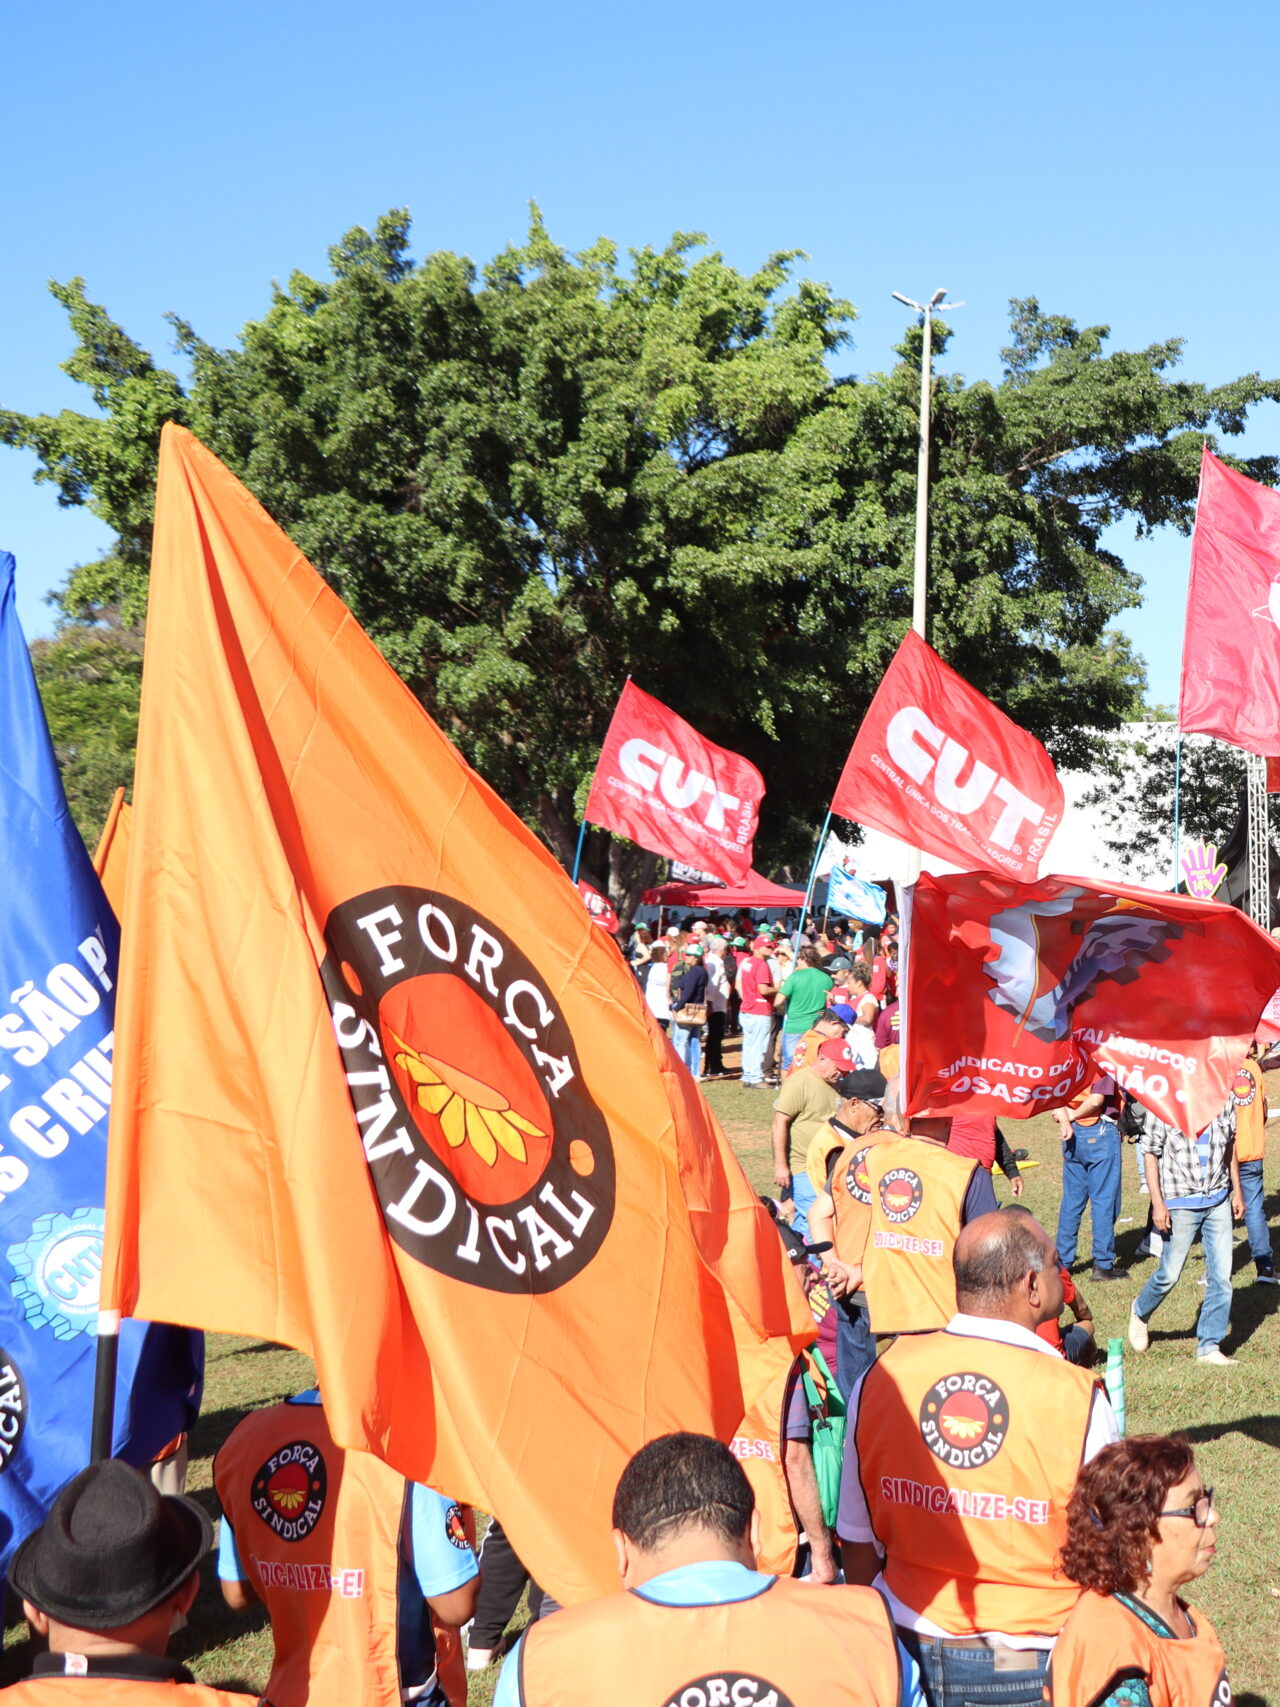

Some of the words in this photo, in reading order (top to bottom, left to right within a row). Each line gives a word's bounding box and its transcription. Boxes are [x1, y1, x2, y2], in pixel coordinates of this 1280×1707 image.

[619, 738, 740, 831] CUT
[871, 753, 904, 789] CENTRAL
[905, 783, 930, 809] ÚNICA
[930, 805, 949, 825] DOS
[887, 707, 1045, 851] CUT
[0, 962, 101, 1067] SÃO
[356, 903, 575, 1098] FORÇA
[936, 1055, 1043, 1079] SINDICATO
[1073, 1028, 1198, 1074] TALÚRGICOS
[950, 1076, 1070, 1104] OSASCO
[332, 1002, 595, 1275] SINDICAL
[884, 1168, 919, 1187] FORÇA
[881, 1198, 920, 1222] DICAL
[936, 1374, 1001, 1408] FORÇA
[268, 1444, 320, 1473] FORÇA
[921, 1420, 1002, 1467] SINDICAL
[254, 1497, 322, 1539] SINDICAL
[881, 1476, 1050, 1524] SINDICALIZE-SE!
[669, 1678, 778, 1707] ORÇA
